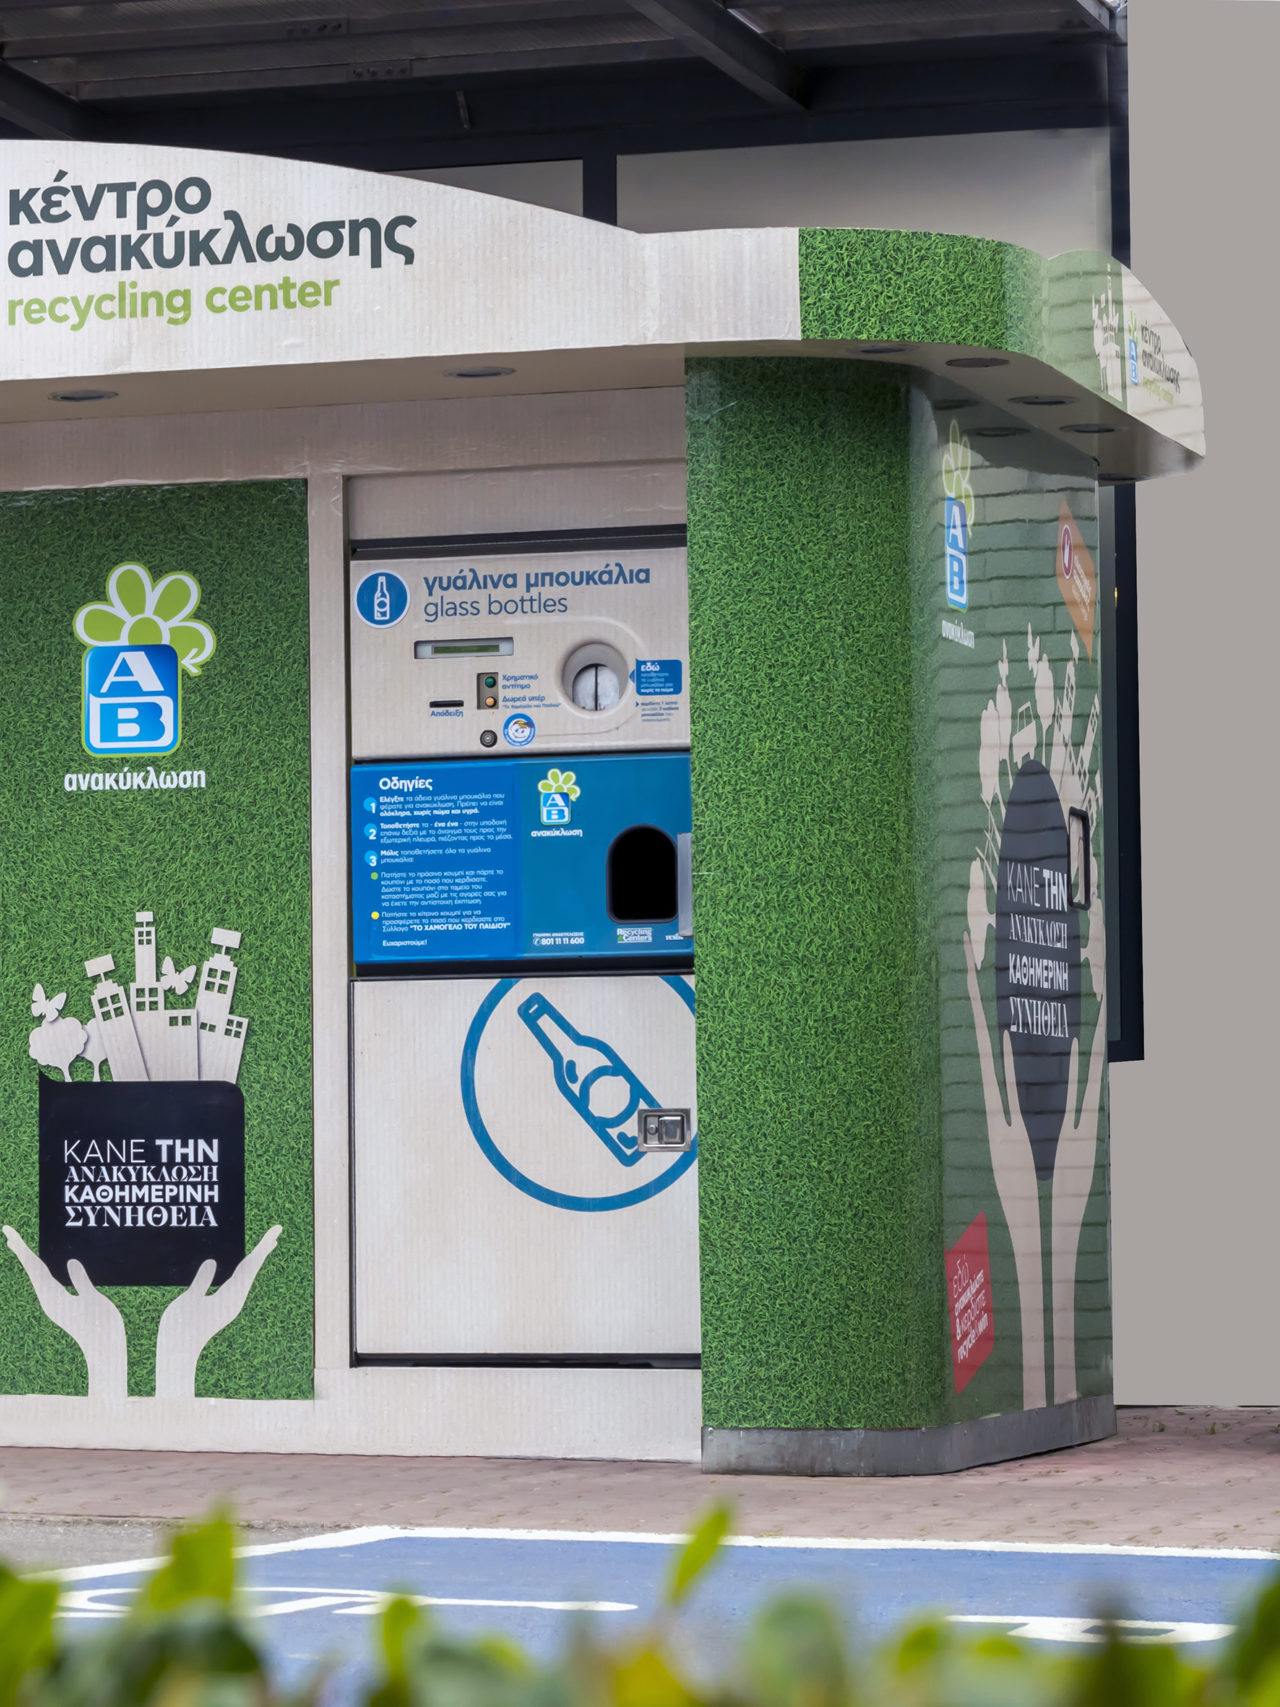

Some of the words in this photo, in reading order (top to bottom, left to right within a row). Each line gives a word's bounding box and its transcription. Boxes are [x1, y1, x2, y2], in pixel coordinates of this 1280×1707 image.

[8, 170, 211, 230] κέντρο
[7, 210, 418, 278] ανακύκλωσης
[8, 281, 191, 331] recycling
[206, 276, 340, 315] center
[423, 567, 518, 596] γυάλινα
[525, 562, 651, 593] μπουκάλια
[423, 594, 480, 623] glass
[488, 593, 568, 616] bottles
[641, 661, 660, 672] εδώ
[430, 709, 464, 719] Απόδειξη
[64, 766, 206, 791] ανακύκλωση
[379, 776, 433, 792] Οδηγίες
[1007, 861, 1040, 907] ΚΑΝΕ
[1042, 869, 1068, 912] ΤΗΝ
[1009, 913, 1068, 949] ΑΝΑΚΥΚΛΩΣΗ
[1009, 953, 1068, 991] ΚΑΘΗΜΕΡΙΝΗ
[1010, 997, 1069, 1038] ΣΥΝΗΘΕΙΑ
[64, 1139, 146, 1164] ΚΑΝΕ
[155, 1139, 219, 1163] ΤΗΝ
[65, 1165, 219, 1183] ΑΝΑΚΥΚΛΩΣΗ
[64, 1185, 219, 1203] ΚΑΘΗΜΕΡΙΝΗ
[64, 1206, 219, 1228] ΣΥΝΗΘΕΙΑ
